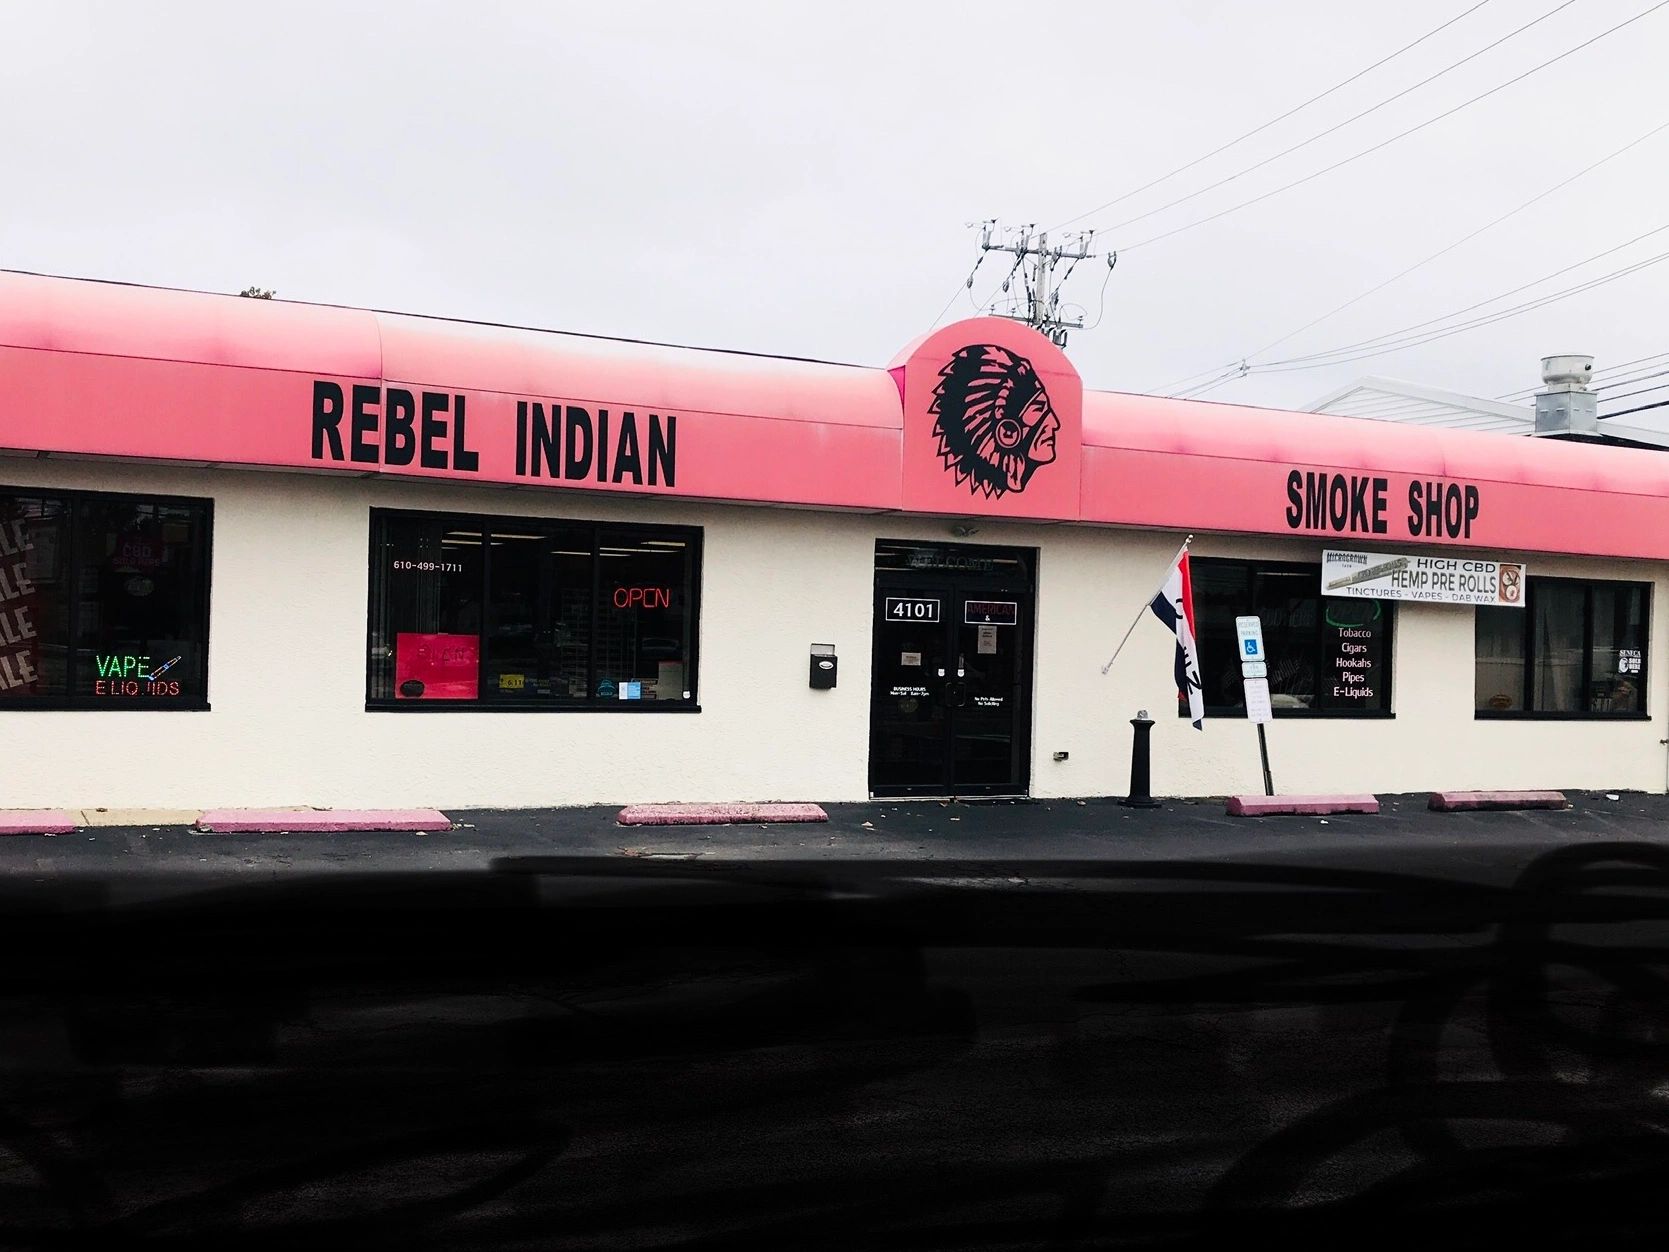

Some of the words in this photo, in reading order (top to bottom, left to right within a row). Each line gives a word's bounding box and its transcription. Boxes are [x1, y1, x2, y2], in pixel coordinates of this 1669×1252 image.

[311, 380, 479, 472] REBEL
[515, 400, 677, 487] INDIAN
[1286, 469, 1388, 534] SMOKE
[1408, 480, 1479, 539] SHOP
[0, 518, 34, 557] LE
[393, 560, 463, 573] 610-499-1711
[1417, 558, 1457, 571] HIGH
[1462, 560, 1496, 573] CBD
[0, 562, 36, 602] LE
[1392, 569, 1429, 589] HEMP
[1432, 572, 1455, 592] PRE
[1459, 573, 1496, 594] ROLLS
[613, 588, 670, 608] OPEN
[1346, 586, 1401, 598] TINCTURES
[1411, 591, 1443, 600] VAPES
[1452, 593, 1471, 602] DAB
[1473, 594, 1496, 603] WAX
[893, 602, 933, 618] 4101
[0, 606, 37, 647] LE
[1338, 627, 1372, 638] Tobacco
[1341, 642, 1367, 655] Cigars
[95, 655, 151, 678] VAPE
[1336, 657, 1372, 668] Hookahs
[1342, 671, 1365, 684] Pipes
[1333, 686, 1374, 700] E-Liquids
